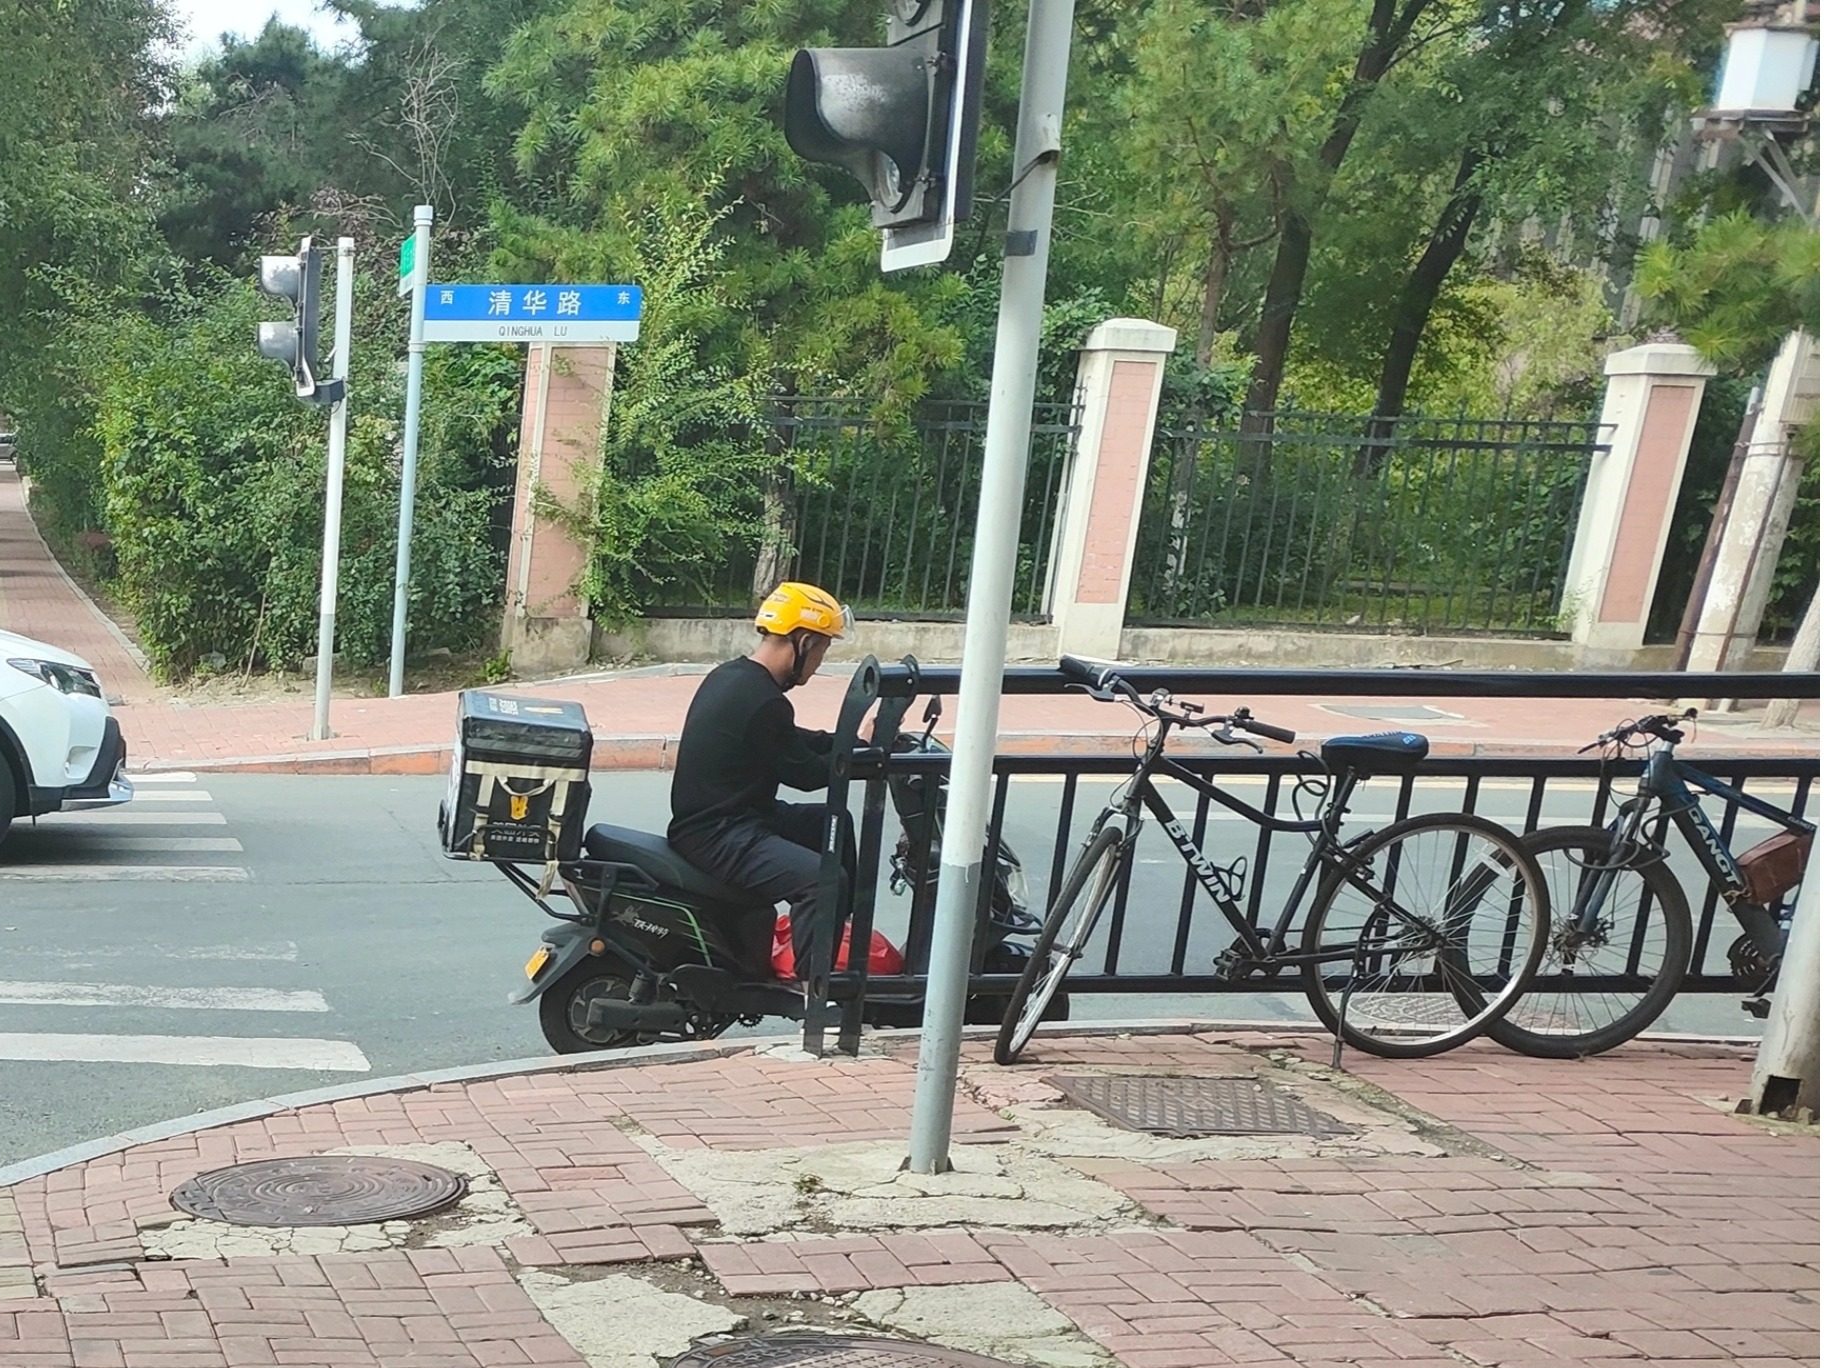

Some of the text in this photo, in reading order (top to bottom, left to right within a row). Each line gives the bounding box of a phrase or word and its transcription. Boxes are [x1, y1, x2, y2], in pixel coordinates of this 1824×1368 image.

[440, 289, 630, 316] 西 清华路 东
[499, 325, 568, 337] QINGHUA LU
[1688, 806, 1746, 887] GANGT
